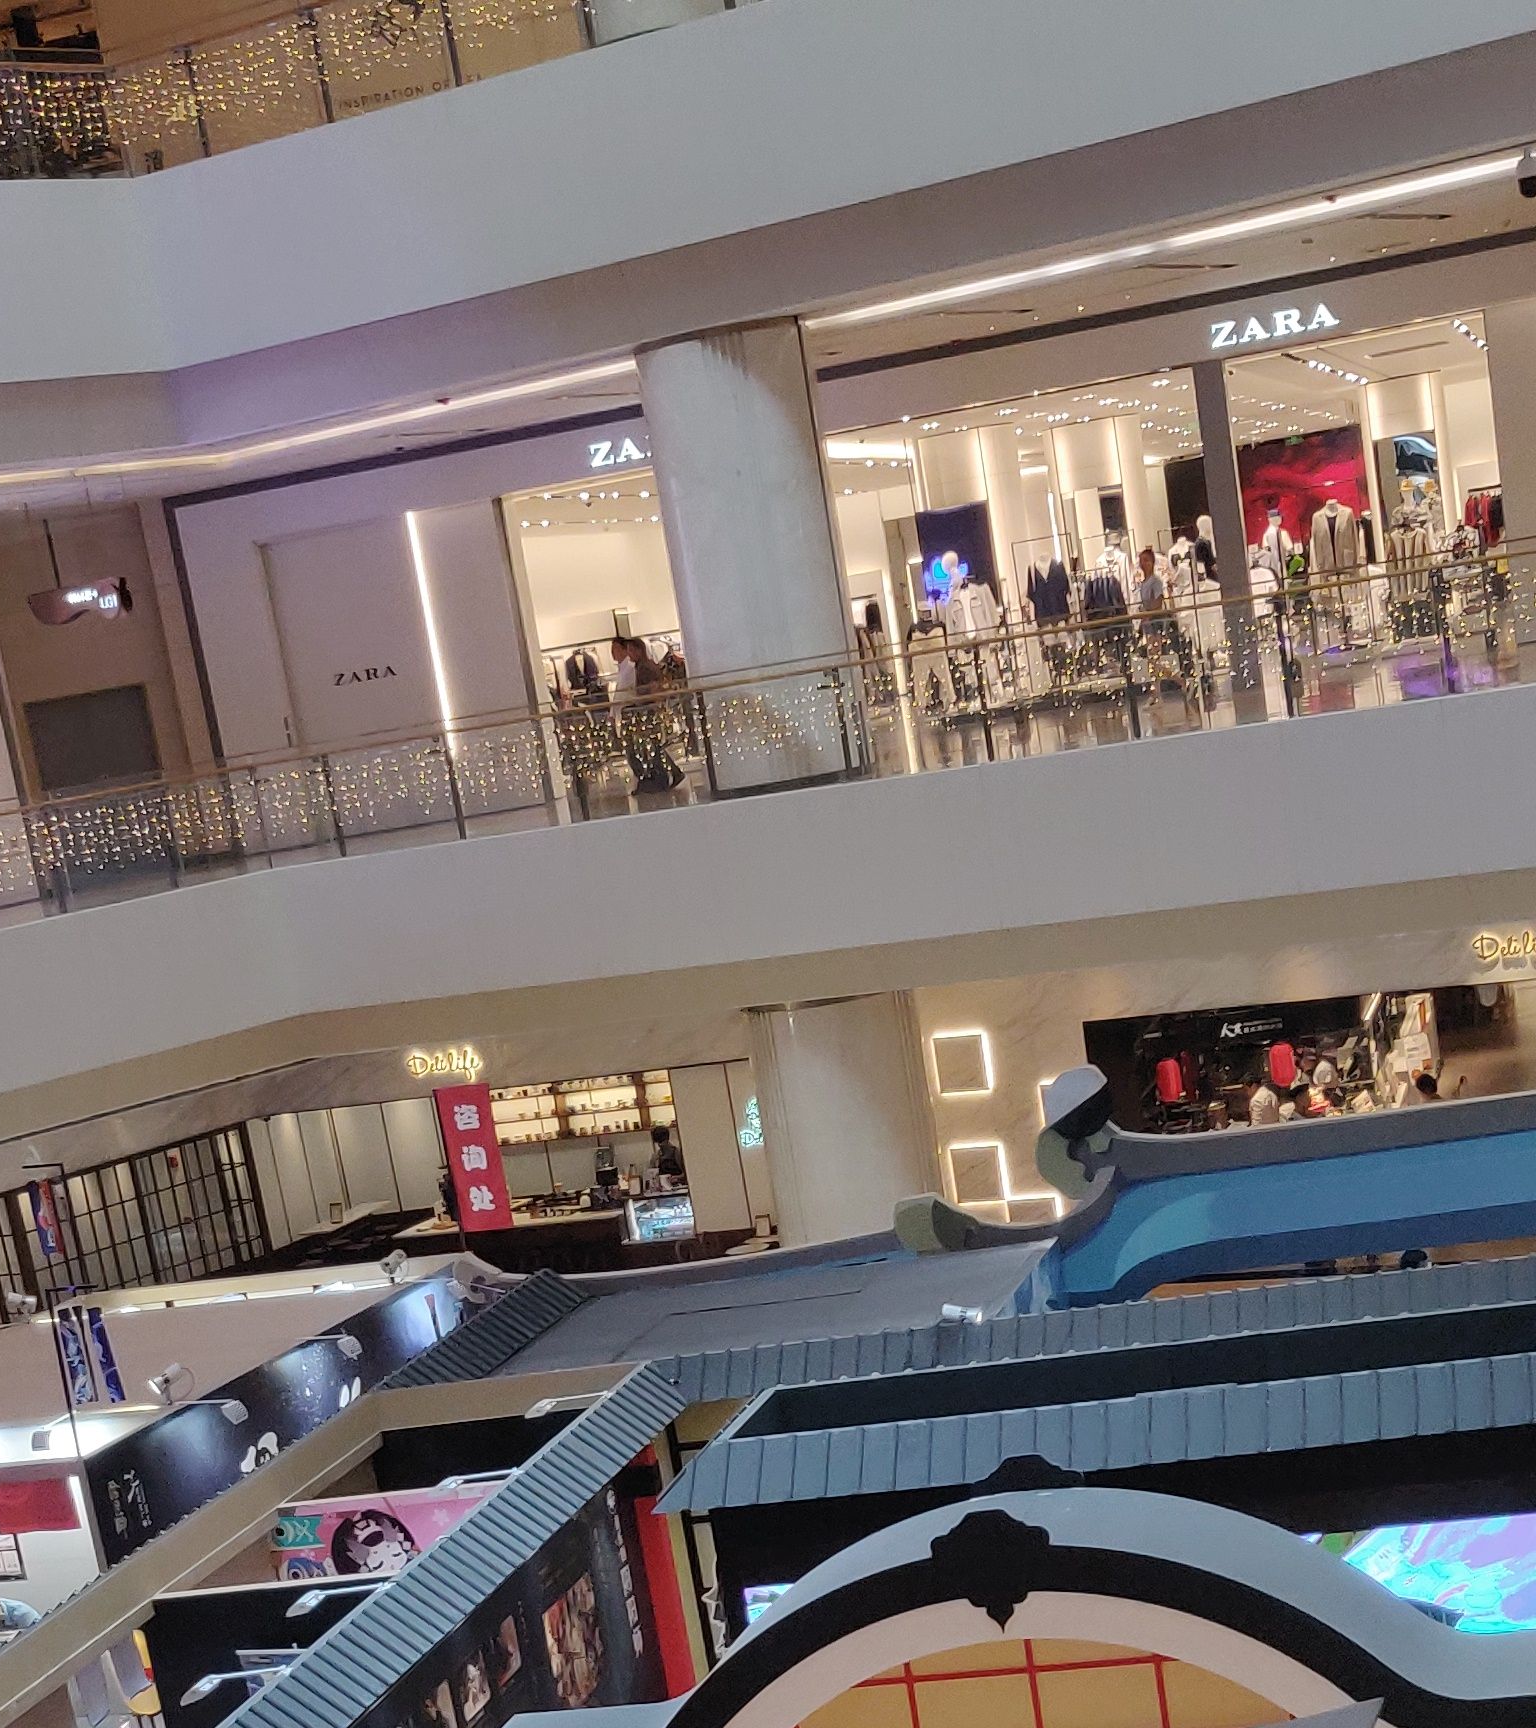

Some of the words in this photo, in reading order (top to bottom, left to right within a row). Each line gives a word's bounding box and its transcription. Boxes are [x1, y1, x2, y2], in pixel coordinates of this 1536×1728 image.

[1210, 303, 1340, 348] ZARA
[588, 434, 652, 467] ZA
[333, 666, 397, 686] ZARA
[1472, 934, 1521, 960] Deli
[407, 1055, 448, 1075] Deli
[448, 1049, 481, 1081] life
[453, 1103, 497, 1212] 咨询处
